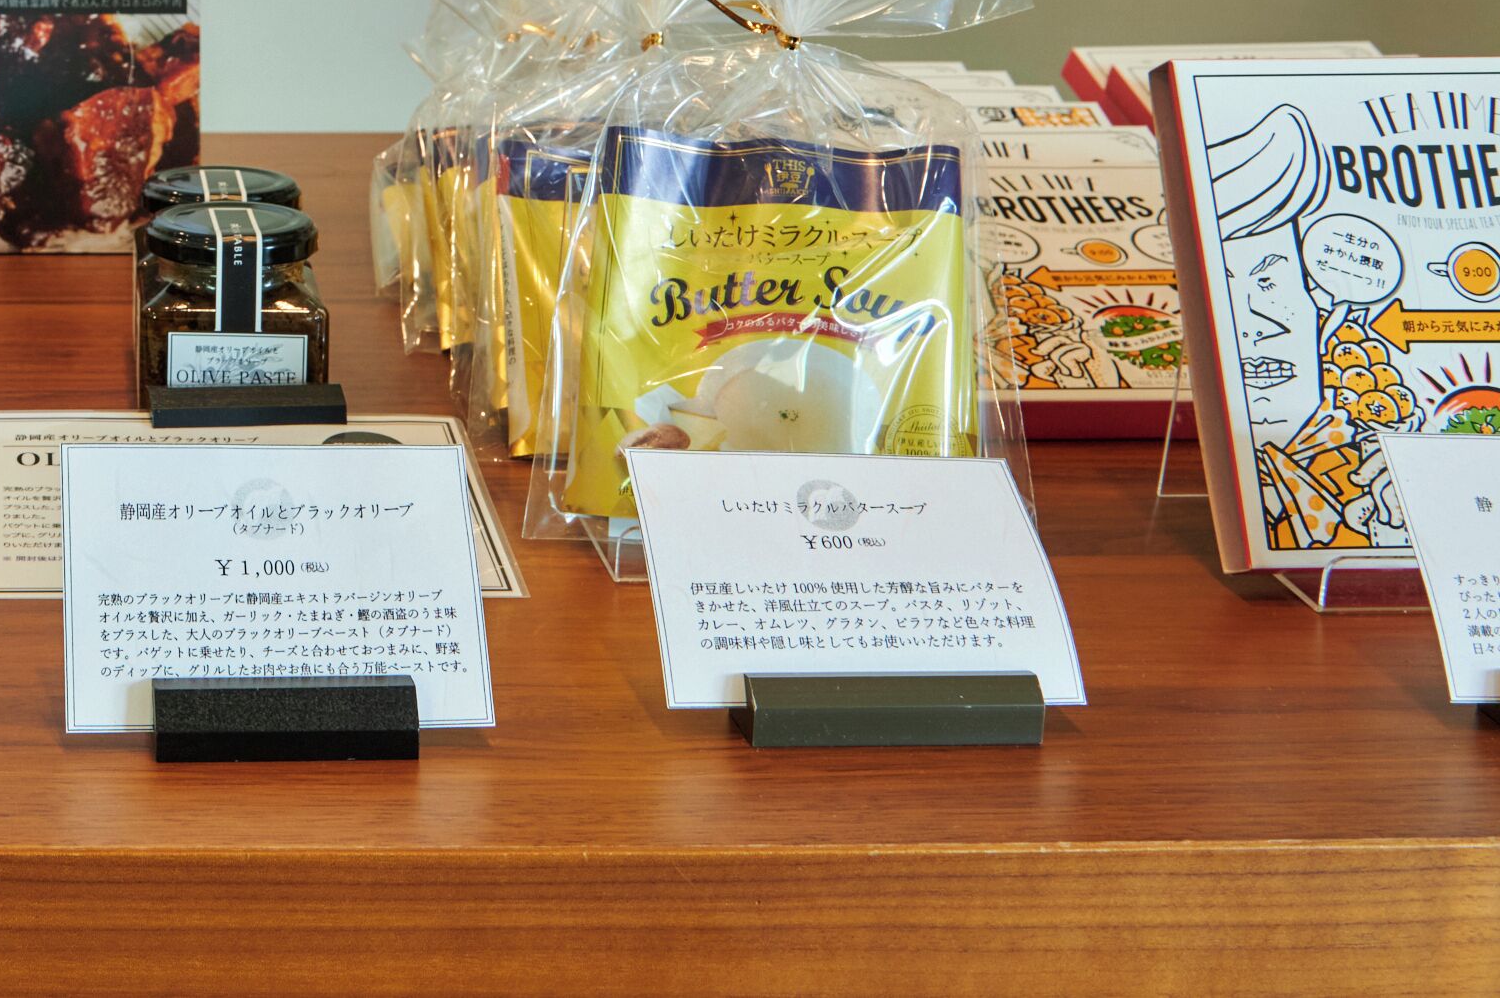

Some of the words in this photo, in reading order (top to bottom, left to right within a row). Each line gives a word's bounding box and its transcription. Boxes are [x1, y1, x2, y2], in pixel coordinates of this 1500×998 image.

[1359, 93, 1430, 137] TEA
[772, 159, 806, 172] THIS
[977, 196, 1153, 224] BROTHERS
[1397, 213, 1420, 228] ENJOY
[1424, 217, 1443, 230] YOUR
[1446, 218, 1478, 230] SPECIAL
[1332, 231, 1380, 251] 一生分の
[1462, 266, 1492, 278] 9:00
[650, 268, 804, 327] Butter
[177, 370, 230, 384] OLIVE
[240, 370, 296, 385] PASTE
[120, 502, 414, 520] 静岡産オリーブオイルとブラックオリーブ
[721, 499, 927, 515] しいたけミラクルバタースープ
[1474, 496, 1492, 513] 静
[800, 534, 853, 550] ¥600
[1463, 607, 1500, 619] 2人の
